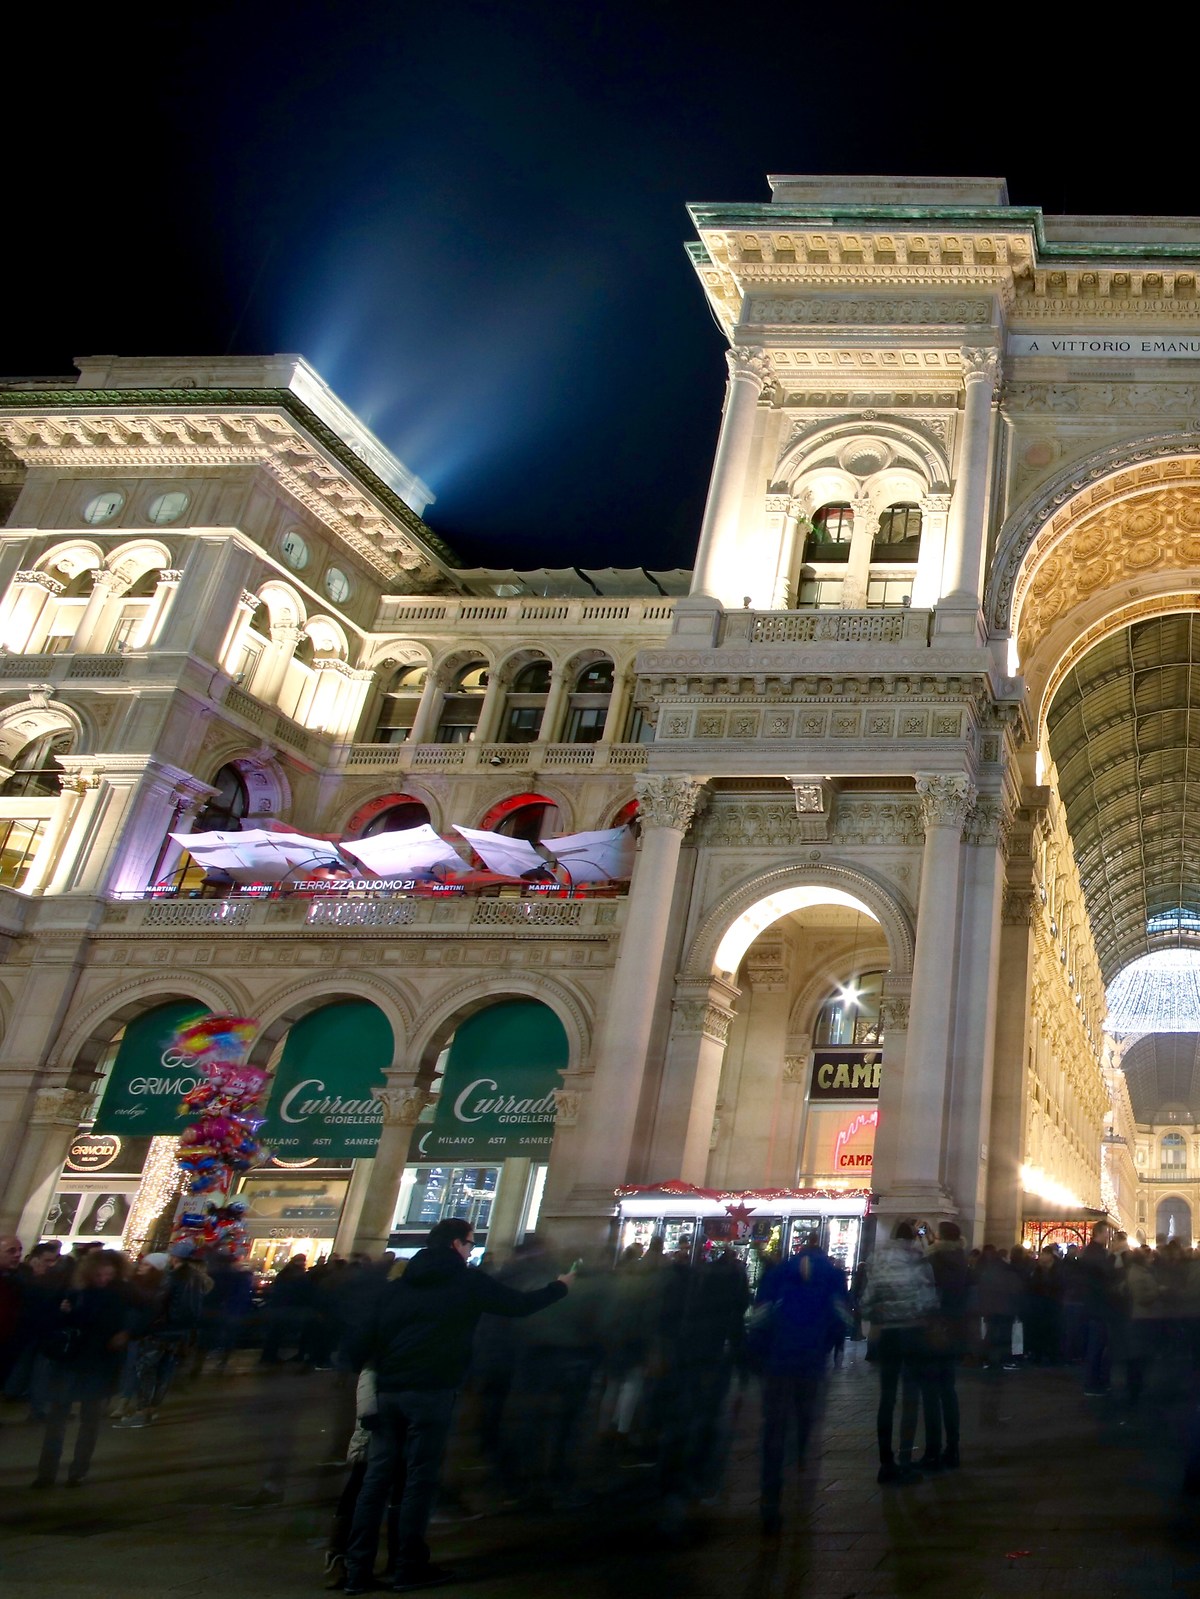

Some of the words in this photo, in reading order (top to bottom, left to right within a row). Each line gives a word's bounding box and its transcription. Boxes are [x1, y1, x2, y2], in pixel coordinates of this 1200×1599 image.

[1029, 341, 1039, 351] A
[1051, 341, 1131, 352] VITTORIO
[292, 880, 355, 890] TERRAZZA
[356, 880, 403, 890] DUOMO
[403, 880, 415, 890] 21
[128, 1077, 210, 1095] GRIMO
[312, 1138, 332, 1146] ASTI
[71, 1145, 114, 1156] GRIMOLDI
[839, 1154, 873, 1167] CAMP
